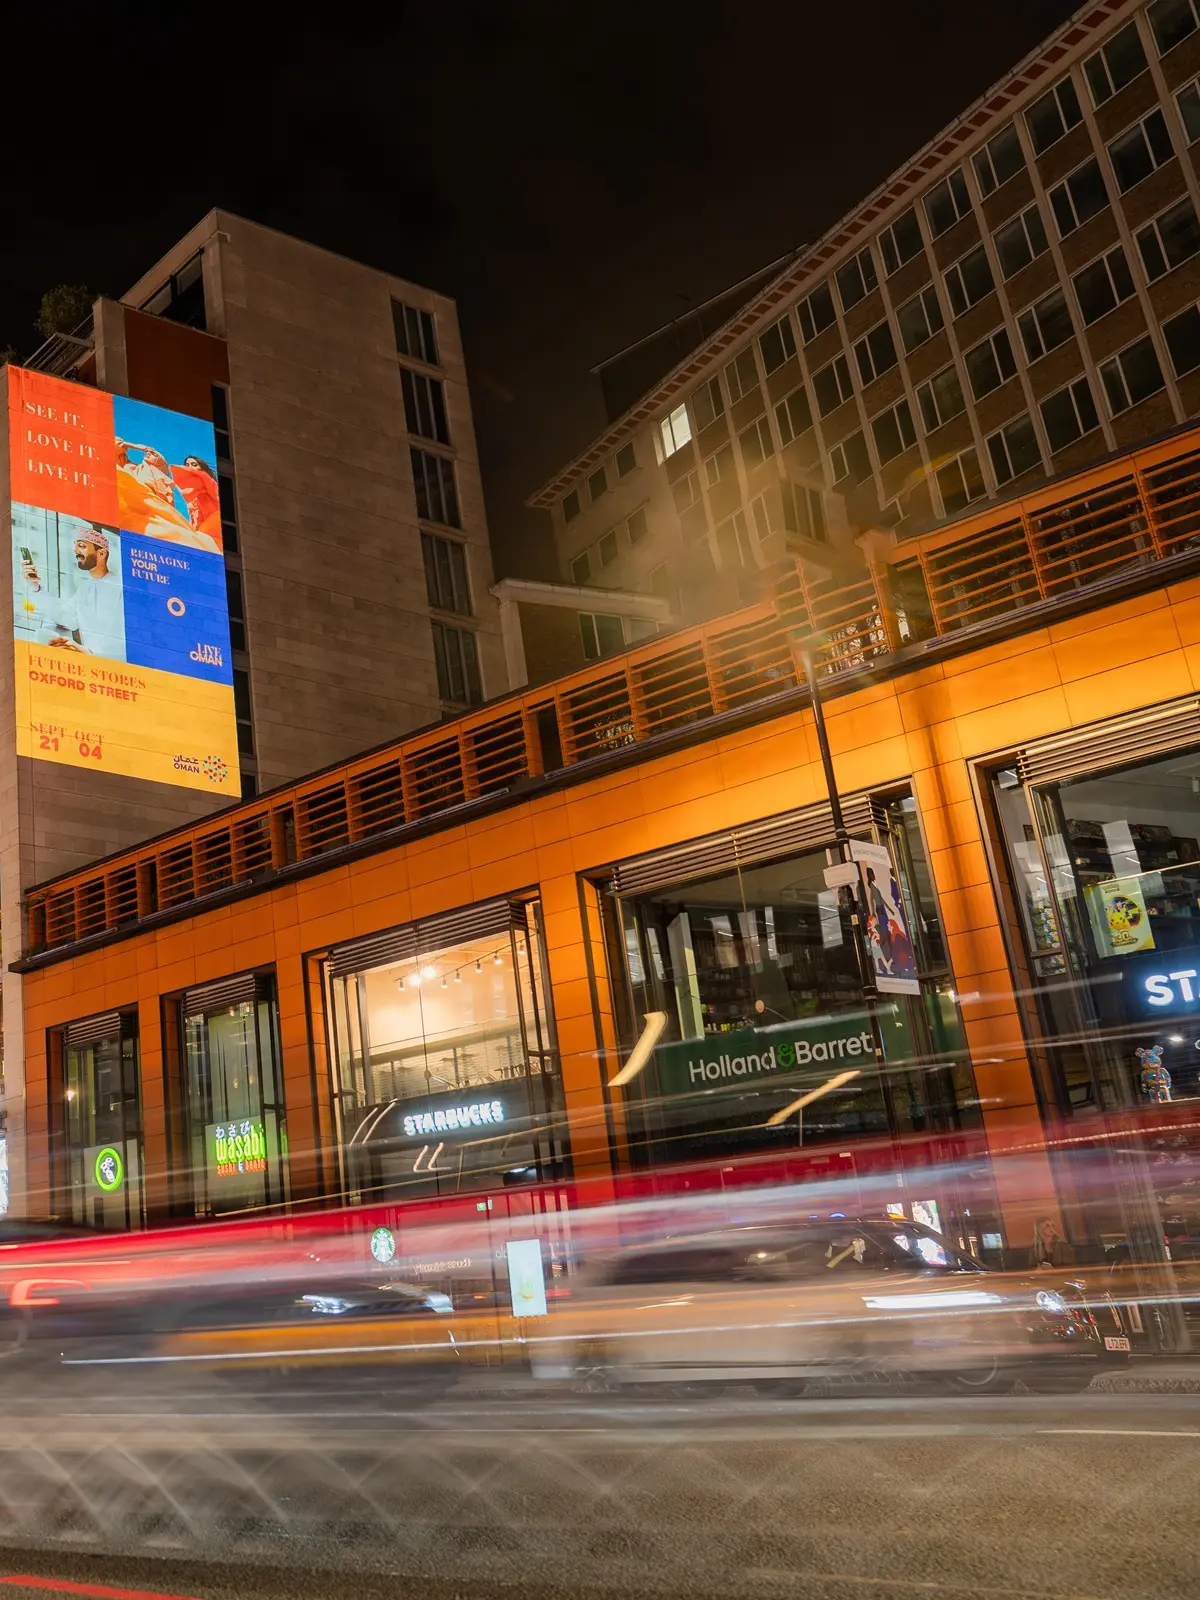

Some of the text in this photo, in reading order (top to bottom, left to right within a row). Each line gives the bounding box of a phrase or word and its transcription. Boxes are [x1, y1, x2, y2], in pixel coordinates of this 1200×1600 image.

[26, 402, 84, 428] SEE IT.
[27, 430, 100, 461] LOVE IT.
[28, 459, 95, 488] LIVE IT.
[130, 548, 190, 570] REIMAGINE
[131, 557, 157, 572] YOUR
[132, 568, 170, 585] FUTURE
[189, 651, 223, 667] OMAN
[197, 642, 222, 657] LIVE
[29, 654, 146, 689] FUTURE STORES
[29, 670, 138, 702] OXFORD STREET
[30, 721, 105, 746] SEPT OCT
[39, 735, 102, 760] 21 04
[174, 762, 200, 773] OMAN
[1145, 969, 1200, 1006] ST
[689, 1046, 776, 1083] Holland
[794, 1031, 874, 1065] Barret
[215, 1120, 251, 1139] わさび
[403, 1100, 504, 1136] STARBUCKS
[216, 1124, 266, 1163] wasabi
[217, 1161, 237, 1176] sushi
